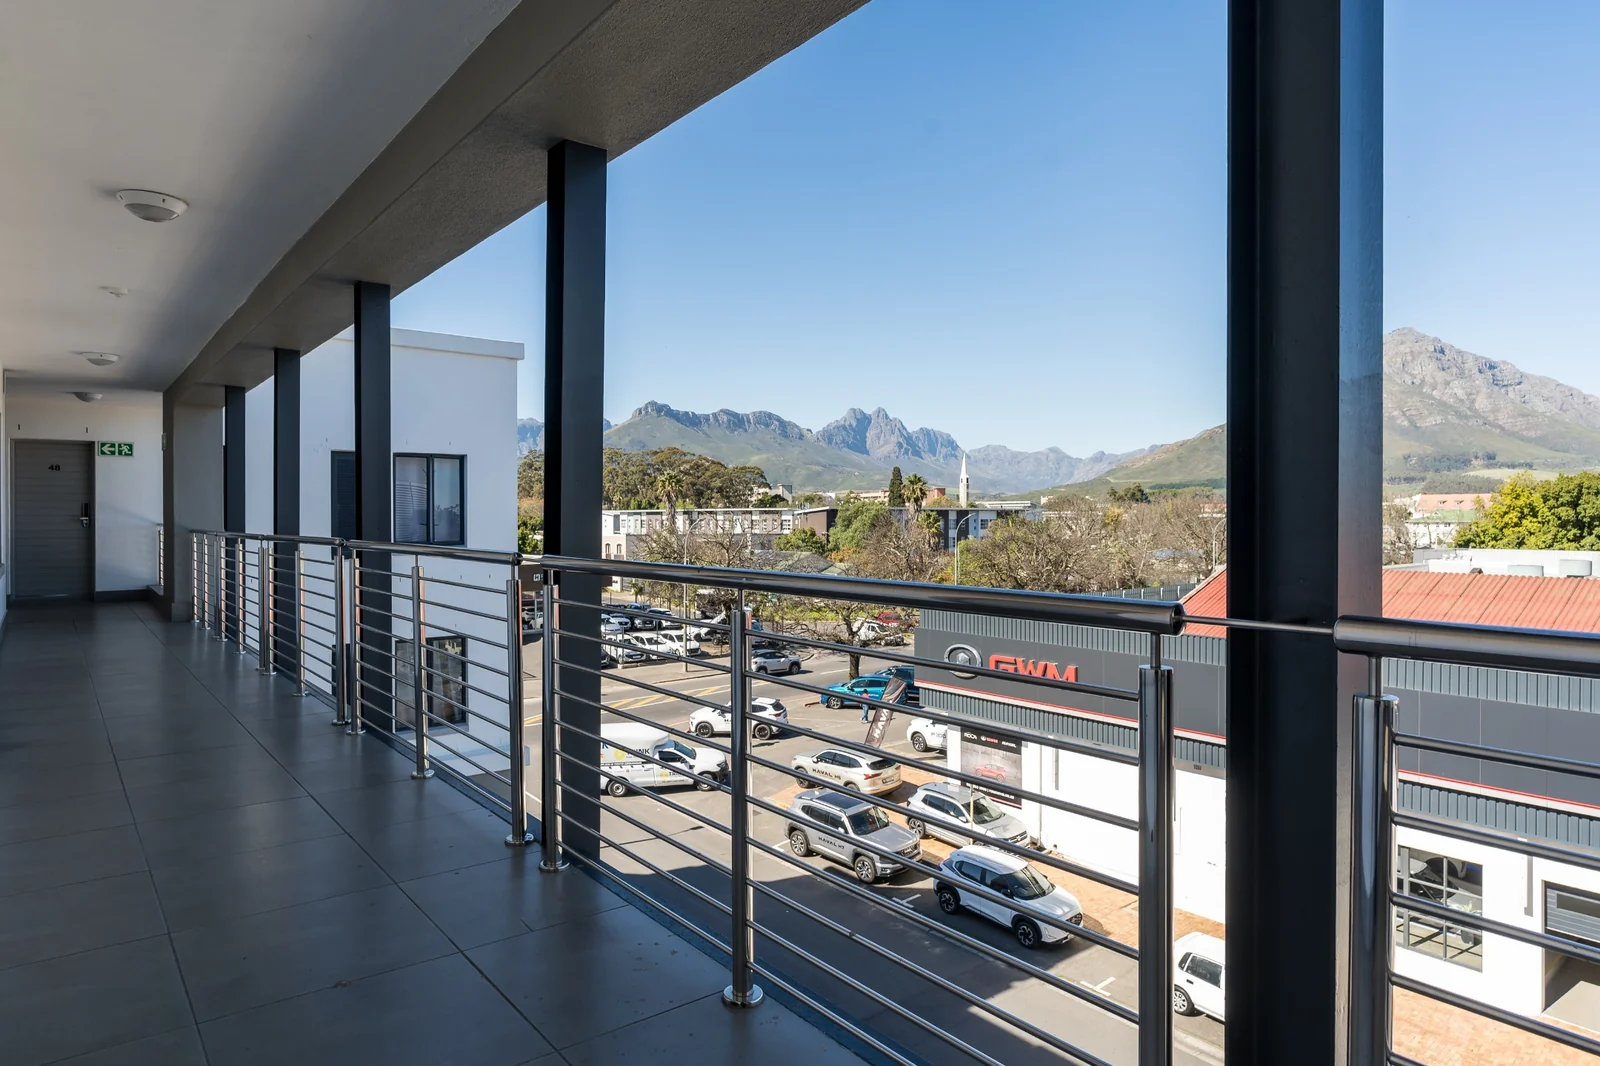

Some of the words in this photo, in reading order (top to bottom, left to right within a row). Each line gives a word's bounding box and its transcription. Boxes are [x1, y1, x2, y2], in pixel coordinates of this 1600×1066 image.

[989, 655, 1078, 682] GWM
[812, 768, 833, 777] HAVAL
[818, 836, 837, 847] HAVAL
